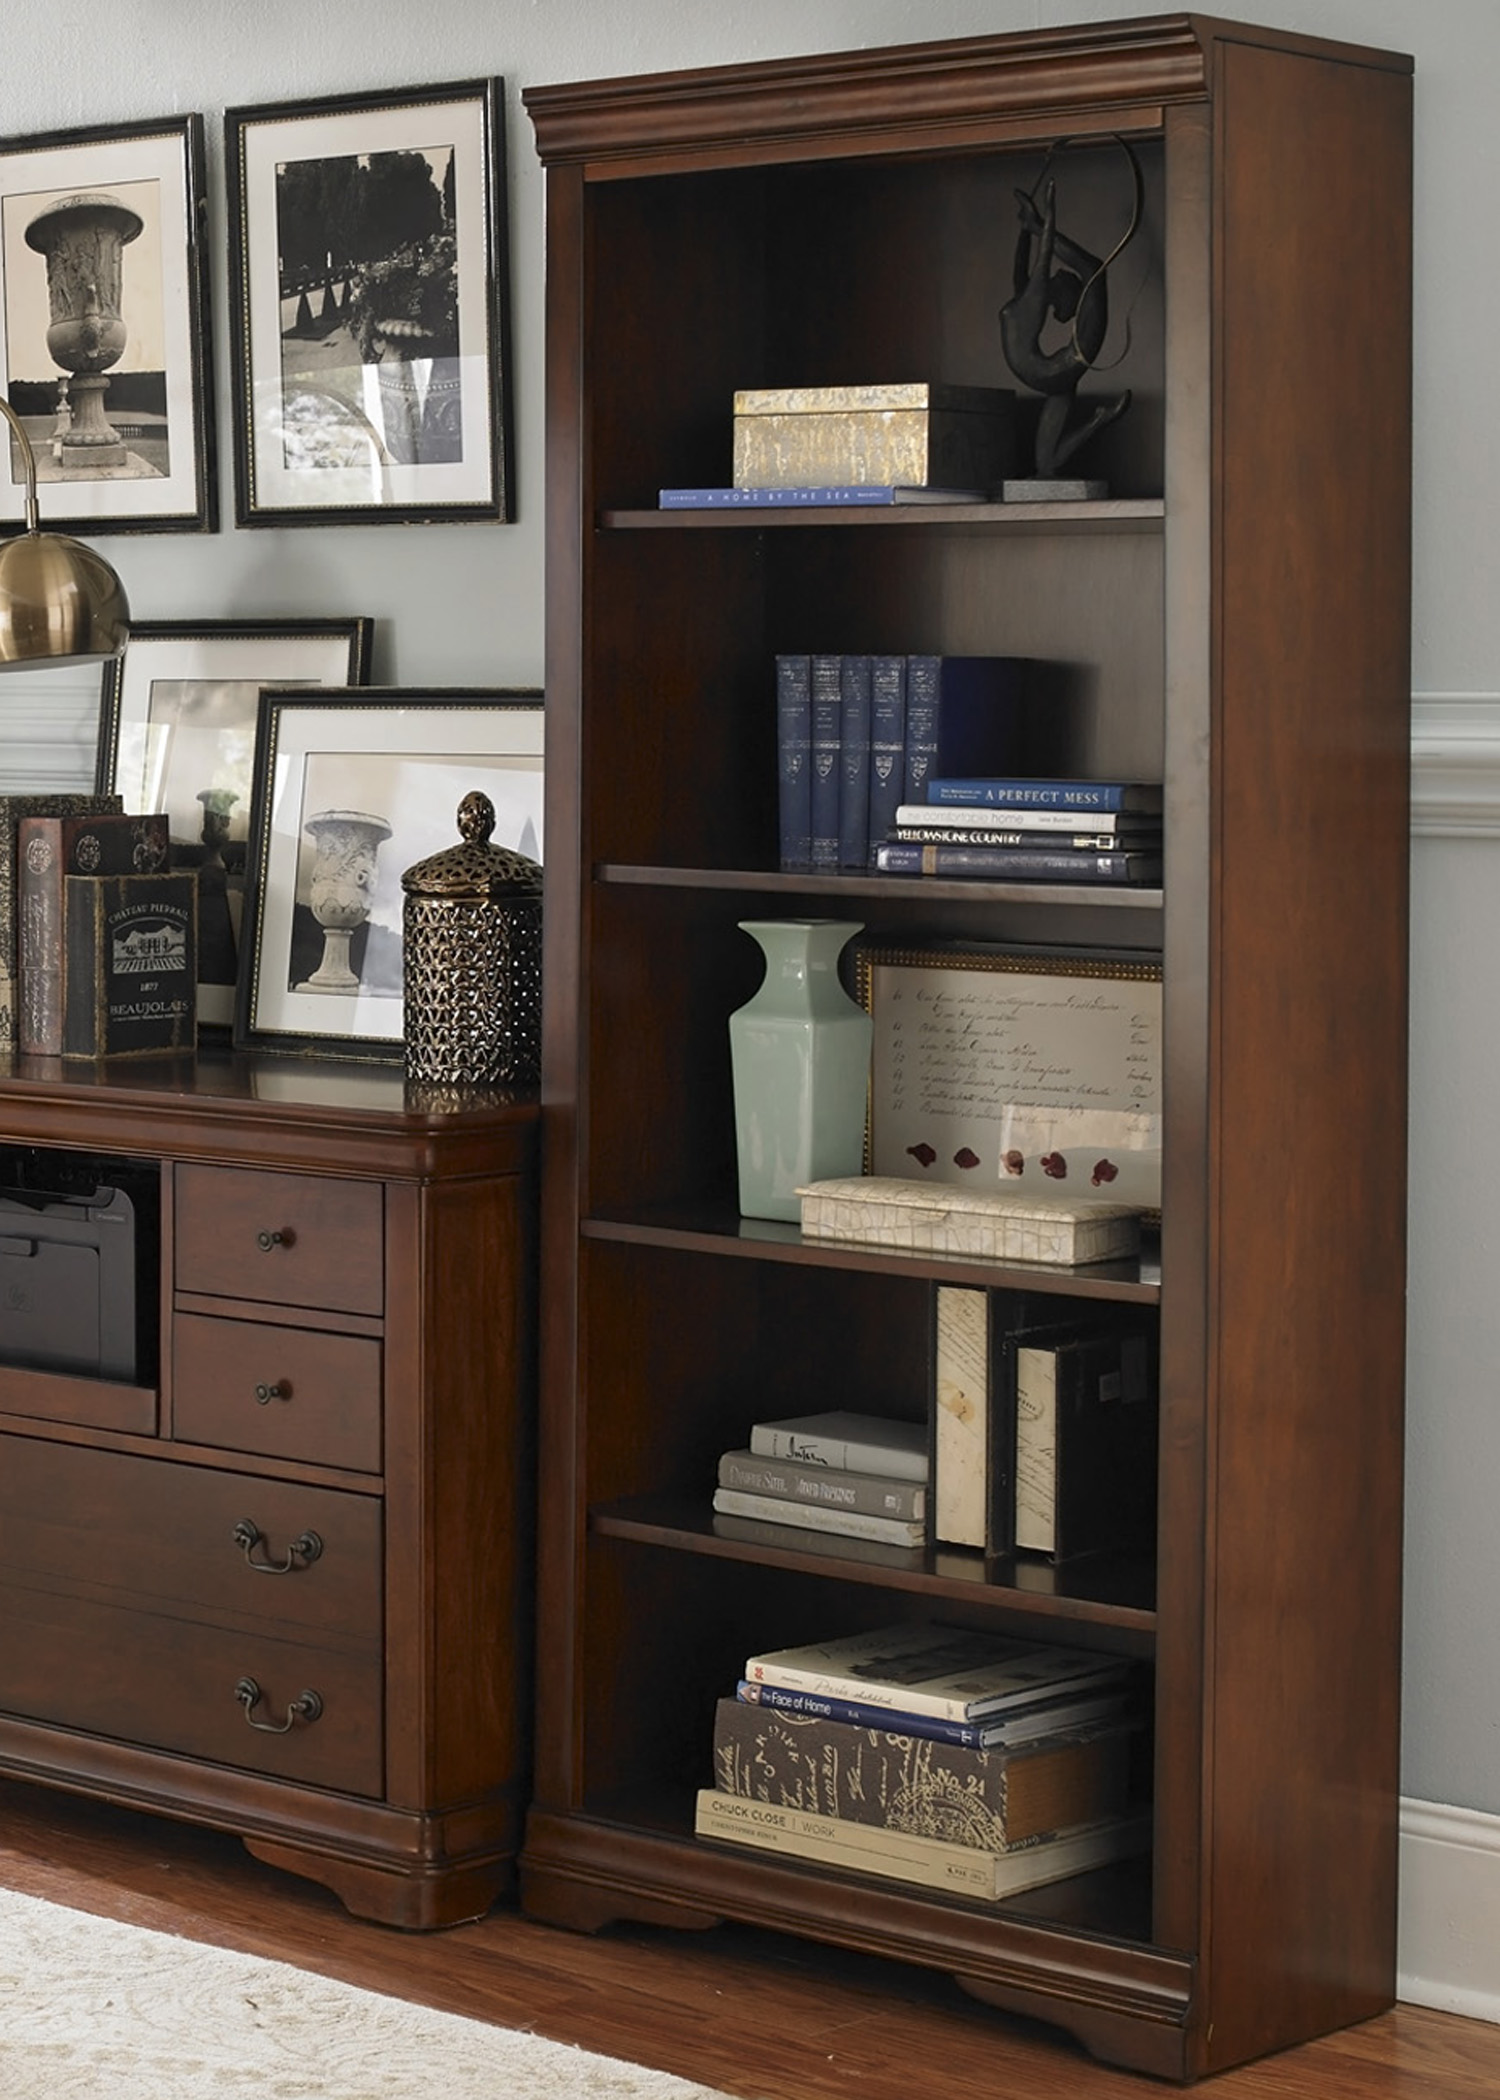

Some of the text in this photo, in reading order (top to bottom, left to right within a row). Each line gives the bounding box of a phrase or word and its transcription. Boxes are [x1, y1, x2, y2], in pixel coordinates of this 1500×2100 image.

[769, 493, 782, 501] BY
[793, 492, 816, 500] THE
[826, 492, 849, 500] SEA
[985, 789, 994, 801] A
[998, 789, 1060, 804] PERFECT
[1064, 792, 1099, 805] MESS
[922, 810, 988, 823] comfortable
[991, 810, 1024, 823] home
[969, 830, 1022, 845] COUNTRY
[108, 904, 146, 924] CHATEAU
[109, 1000, 190, 1016] BEAUJOLAIS
[771, 1691, 792, 1708] Face
[793, 1696, 804, 1709] of
[804, 1699, 832, 1716] Home
[712, 1800, 836, 1838] CHUCK CLOSE WORK
